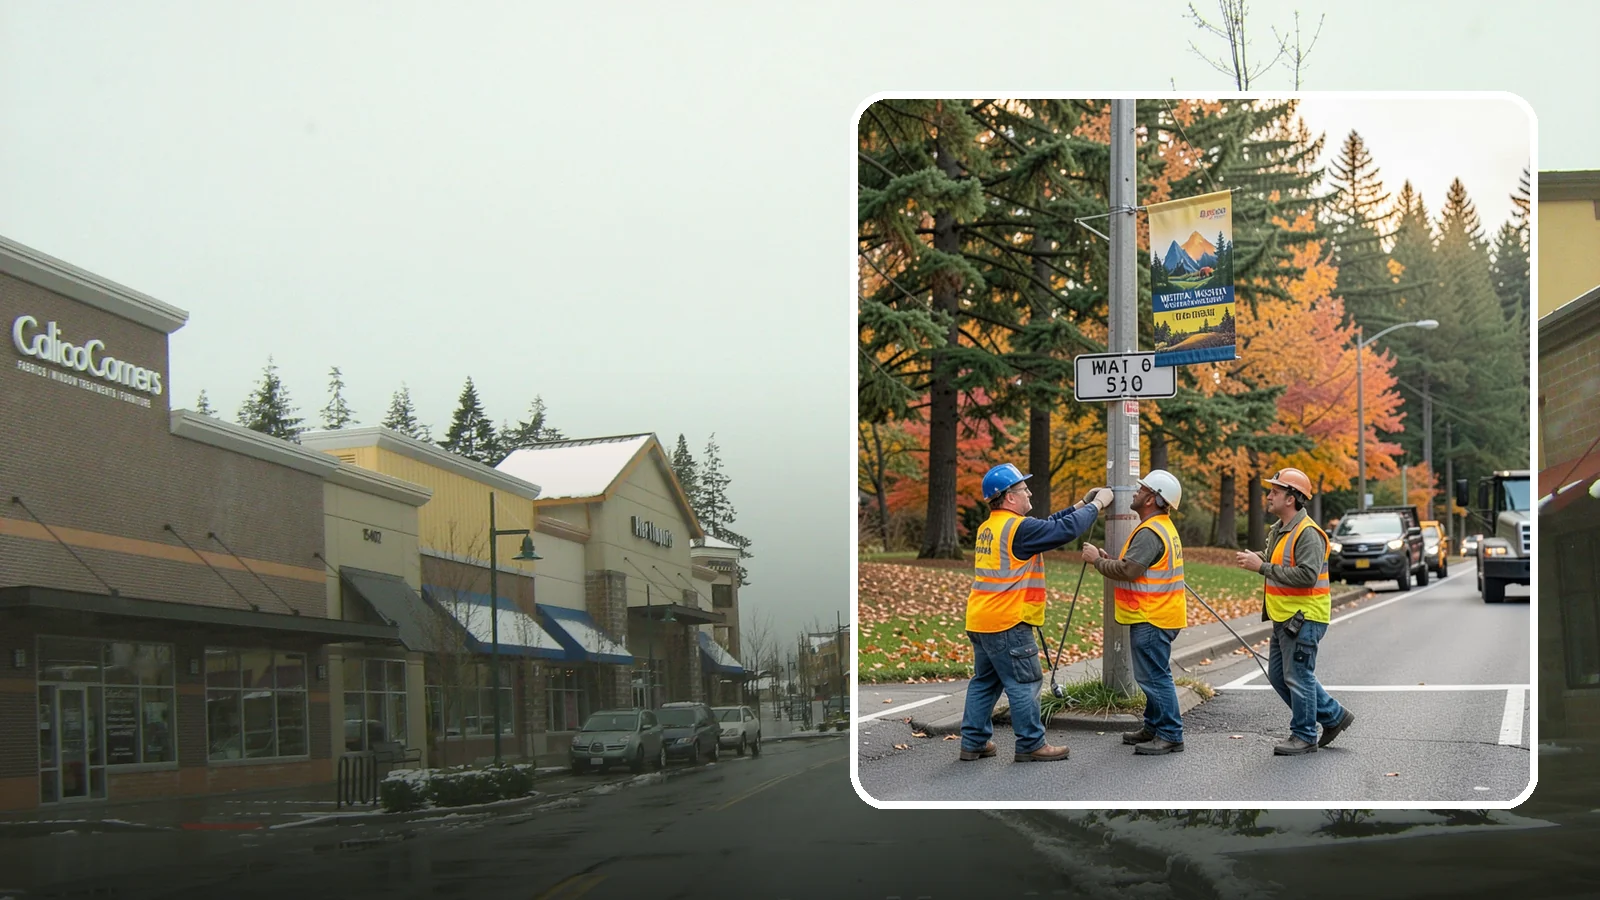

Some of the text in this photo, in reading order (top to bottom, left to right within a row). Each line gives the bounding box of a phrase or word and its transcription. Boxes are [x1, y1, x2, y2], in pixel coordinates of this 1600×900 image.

[17, 360, 151, 408] FABRICS WINDOW TREATMENTS FURNITURE
